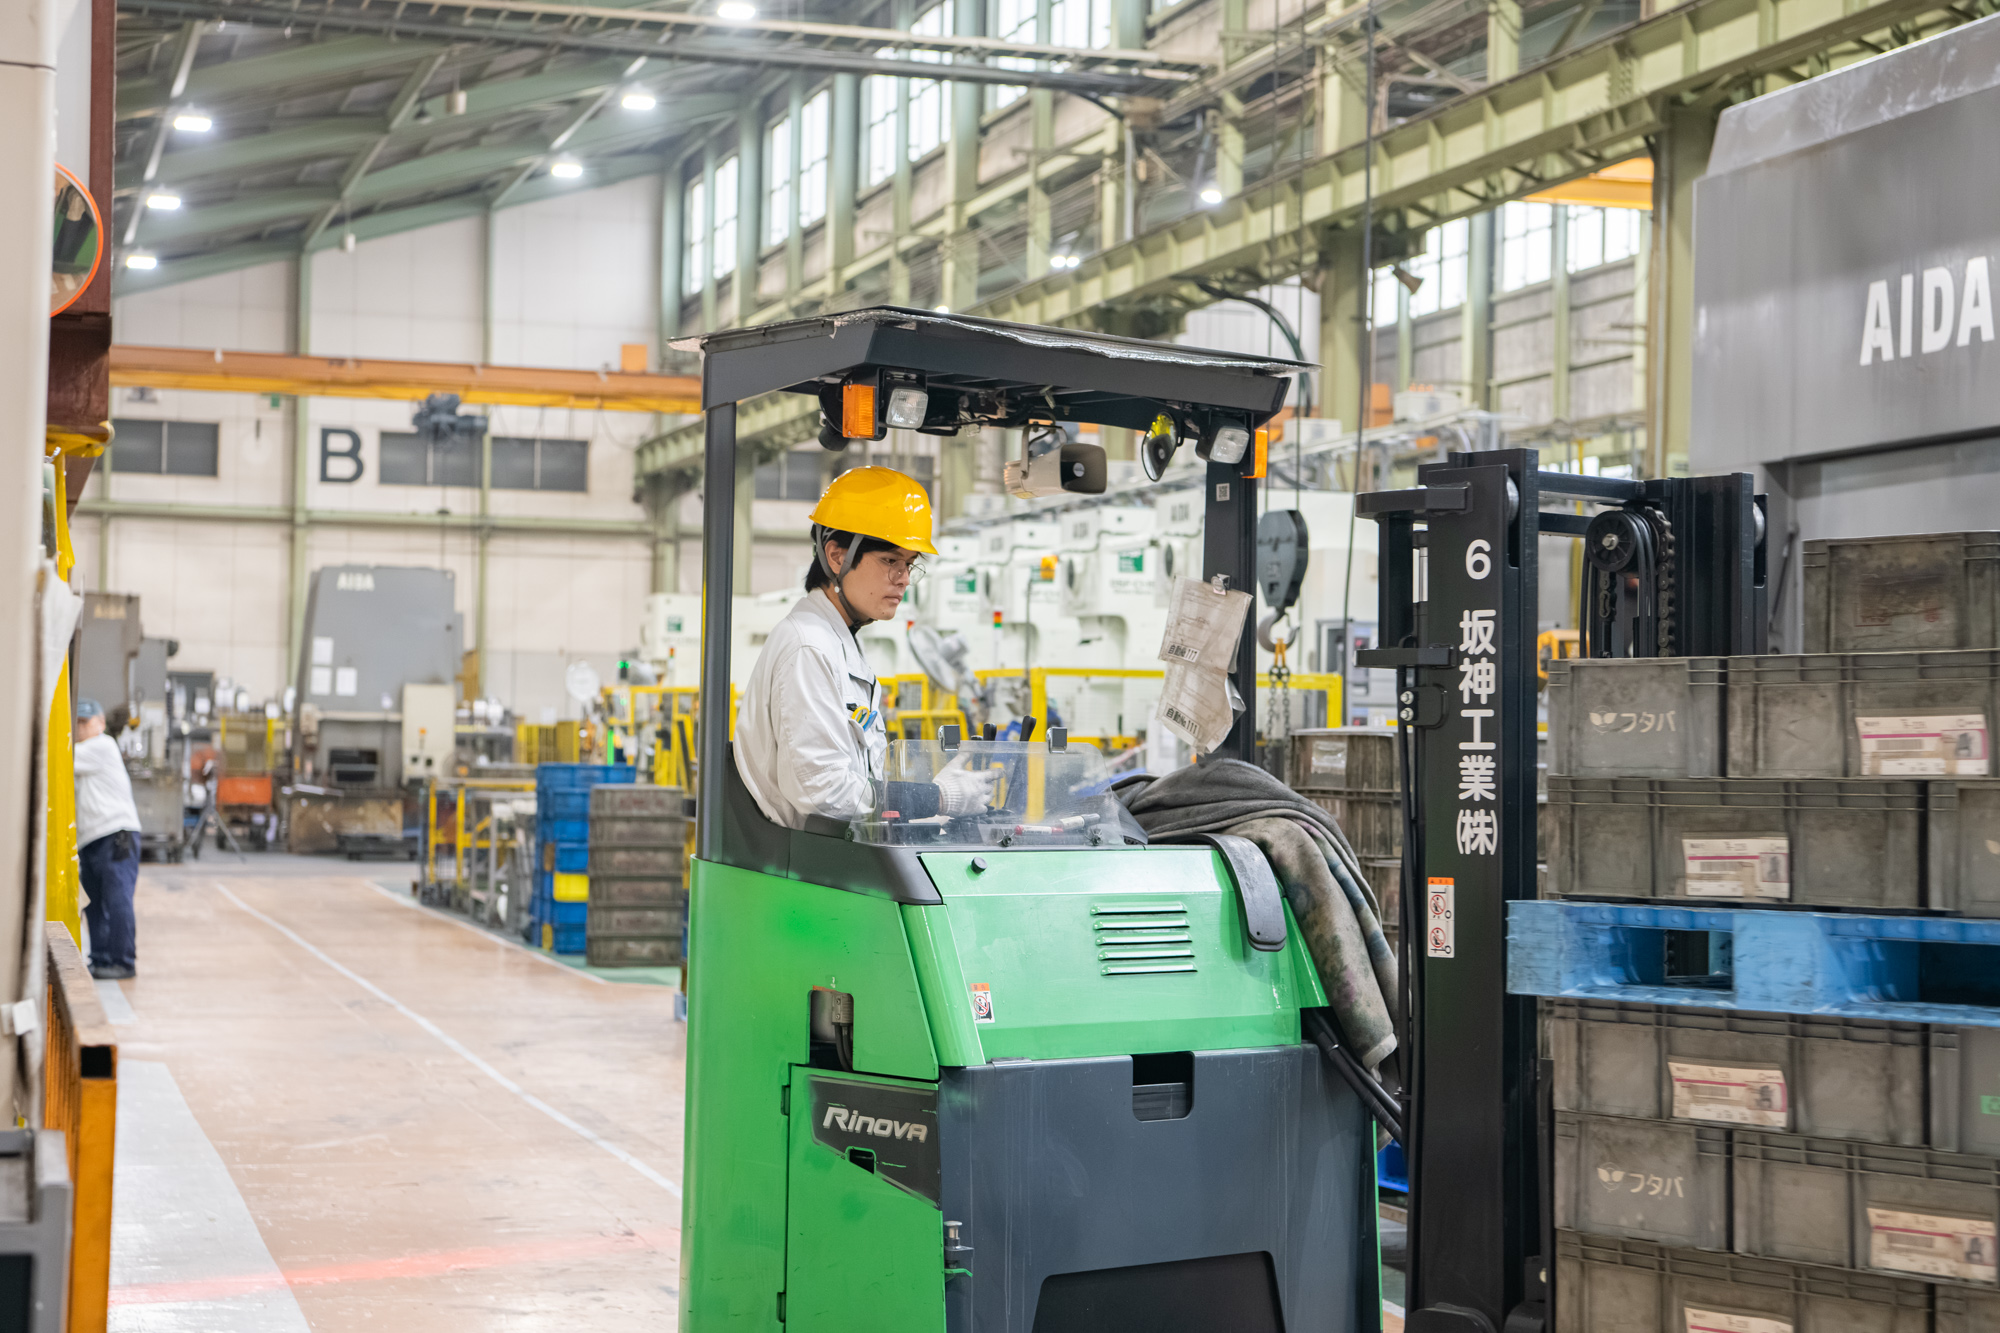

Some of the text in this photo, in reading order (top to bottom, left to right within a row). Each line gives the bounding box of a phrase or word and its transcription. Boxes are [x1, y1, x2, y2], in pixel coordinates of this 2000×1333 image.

[1859, 256, 1995, 366] AIDA
[320, 428, 364, 483] B
[1465, 539, 1492, 581] 6
[1620, 710, 1676, 733] フタバ
[823, 1106, 928, 1143] Rinova
[1629, 1173, 1684, 1198] フタバ
